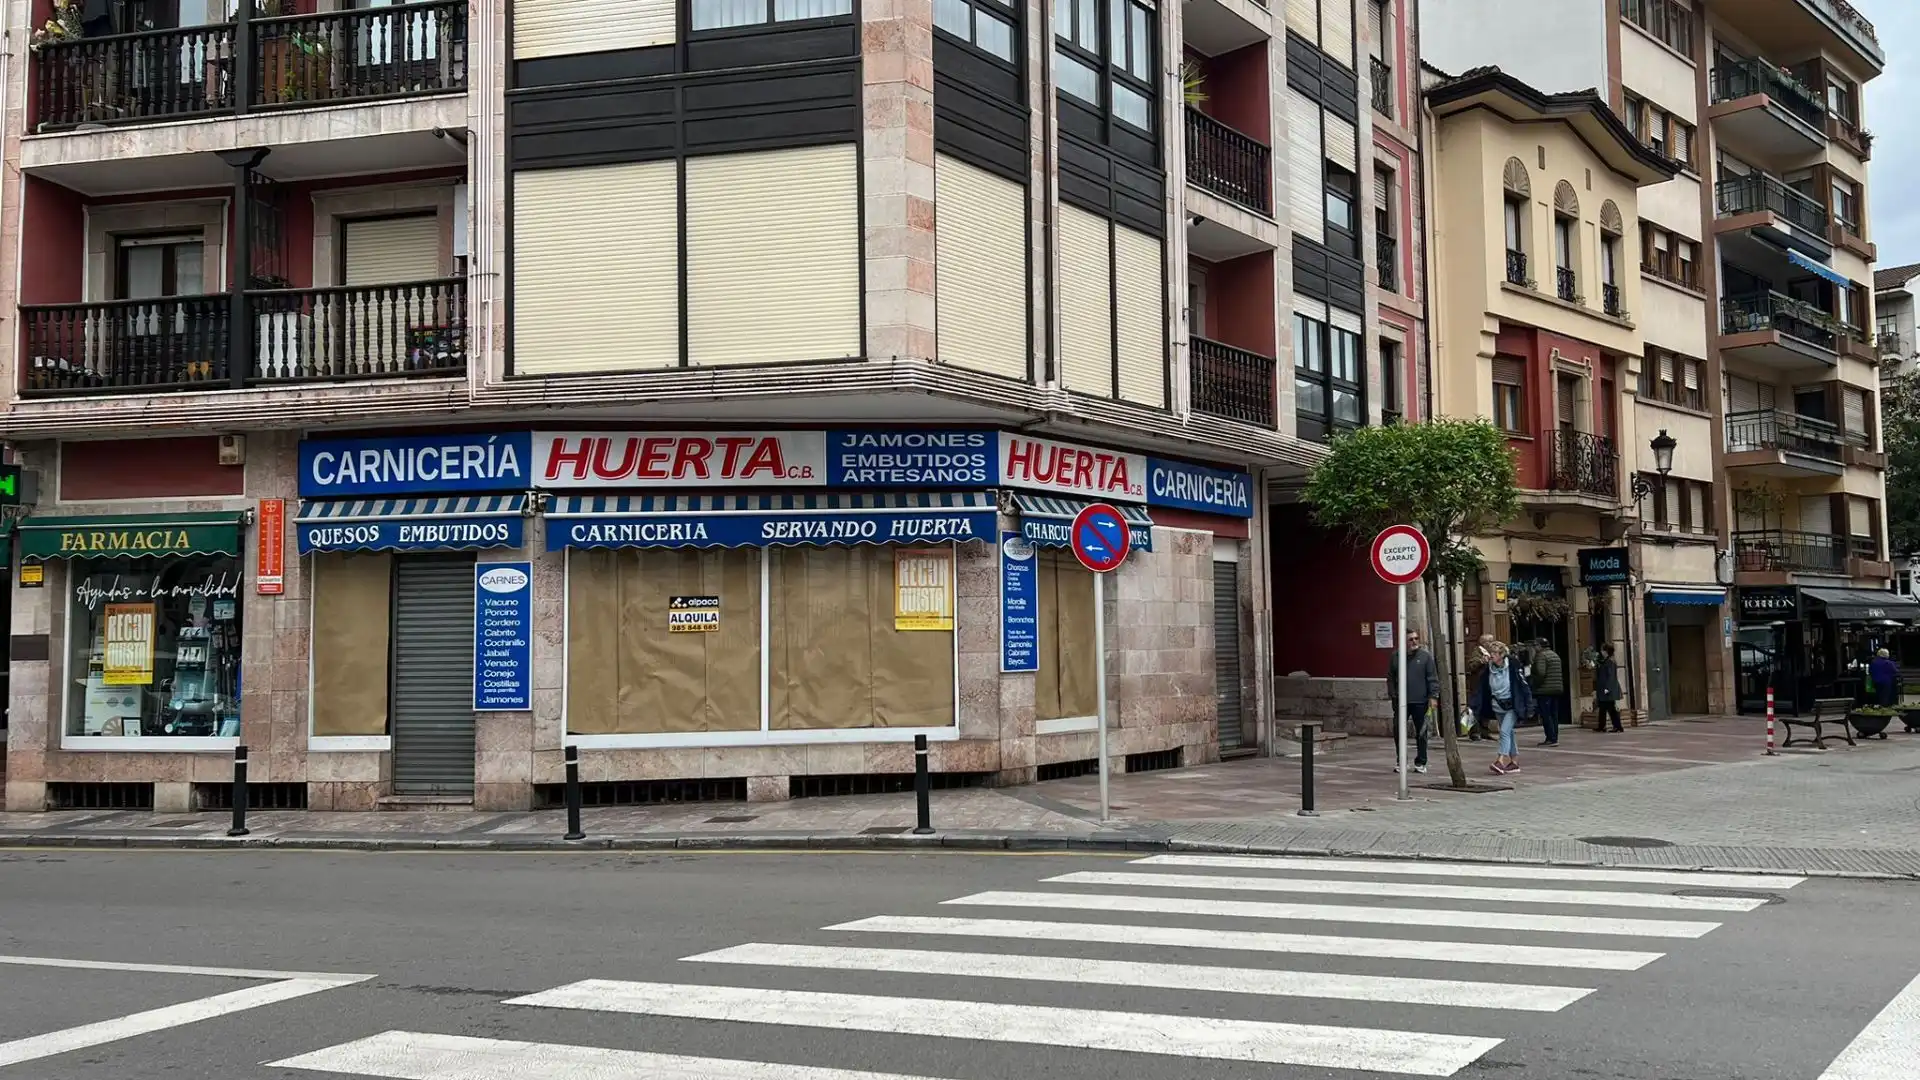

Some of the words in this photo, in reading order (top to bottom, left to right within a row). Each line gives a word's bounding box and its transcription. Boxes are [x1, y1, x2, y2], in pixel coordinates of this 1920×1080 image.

[841, 433, 986, 448] JAMONES
[312, 435, 521, 485] CARNICERÍA
[544, 436, 788, 481] HUERTA
[787, 466, 815, 479] C.B.
[841, 453, 987, 468] EMBUTIDOS
[1006, 439, 1131, 495] HUERTA
[842, 468, 987, 483] ARTESANOS
[1152, 467, 1248, 508] CARNICERÍA
[308, 525, 380, 547] QUESOS
[398, 523, 509, 543] EMBUTIDOS
[571, 522, 709, 542] CARNICERIA
[761, 520, 877, 539] SERVANDO
[890, 518, 973, 537] HUERTA
[60, 530, 190, 551] FARMACIA
[1383, 546, 1417, 555] EXCEPTO
[1385, 554, 1415, 562] GARAJE
[1590, 556, 1620, 570] Moda
[481, 575, 526, 585] CARNES
[76, 574, 133, 610] Ayudas
[135, 586, 147, 596] a
[150, 576, 169, 598] la
[171, 571, 242, 599] movilidad
[484, 598, 519, 606] Vacuno
[688, 598, 718, 607] alpaca
[484, 608, 519, 616] Porcino
[670, 612, 718, 623] ALQUILA
[484, 618, 521, 626] Cordero
[484, 628, 516, 637] Cabrito
[484, 638, 526, 647] Cochinillo
[483, 659, 519, 667] Venado
[483, 669, 515, 679] Conejo
[483, 679, 520, 688] Costillas
